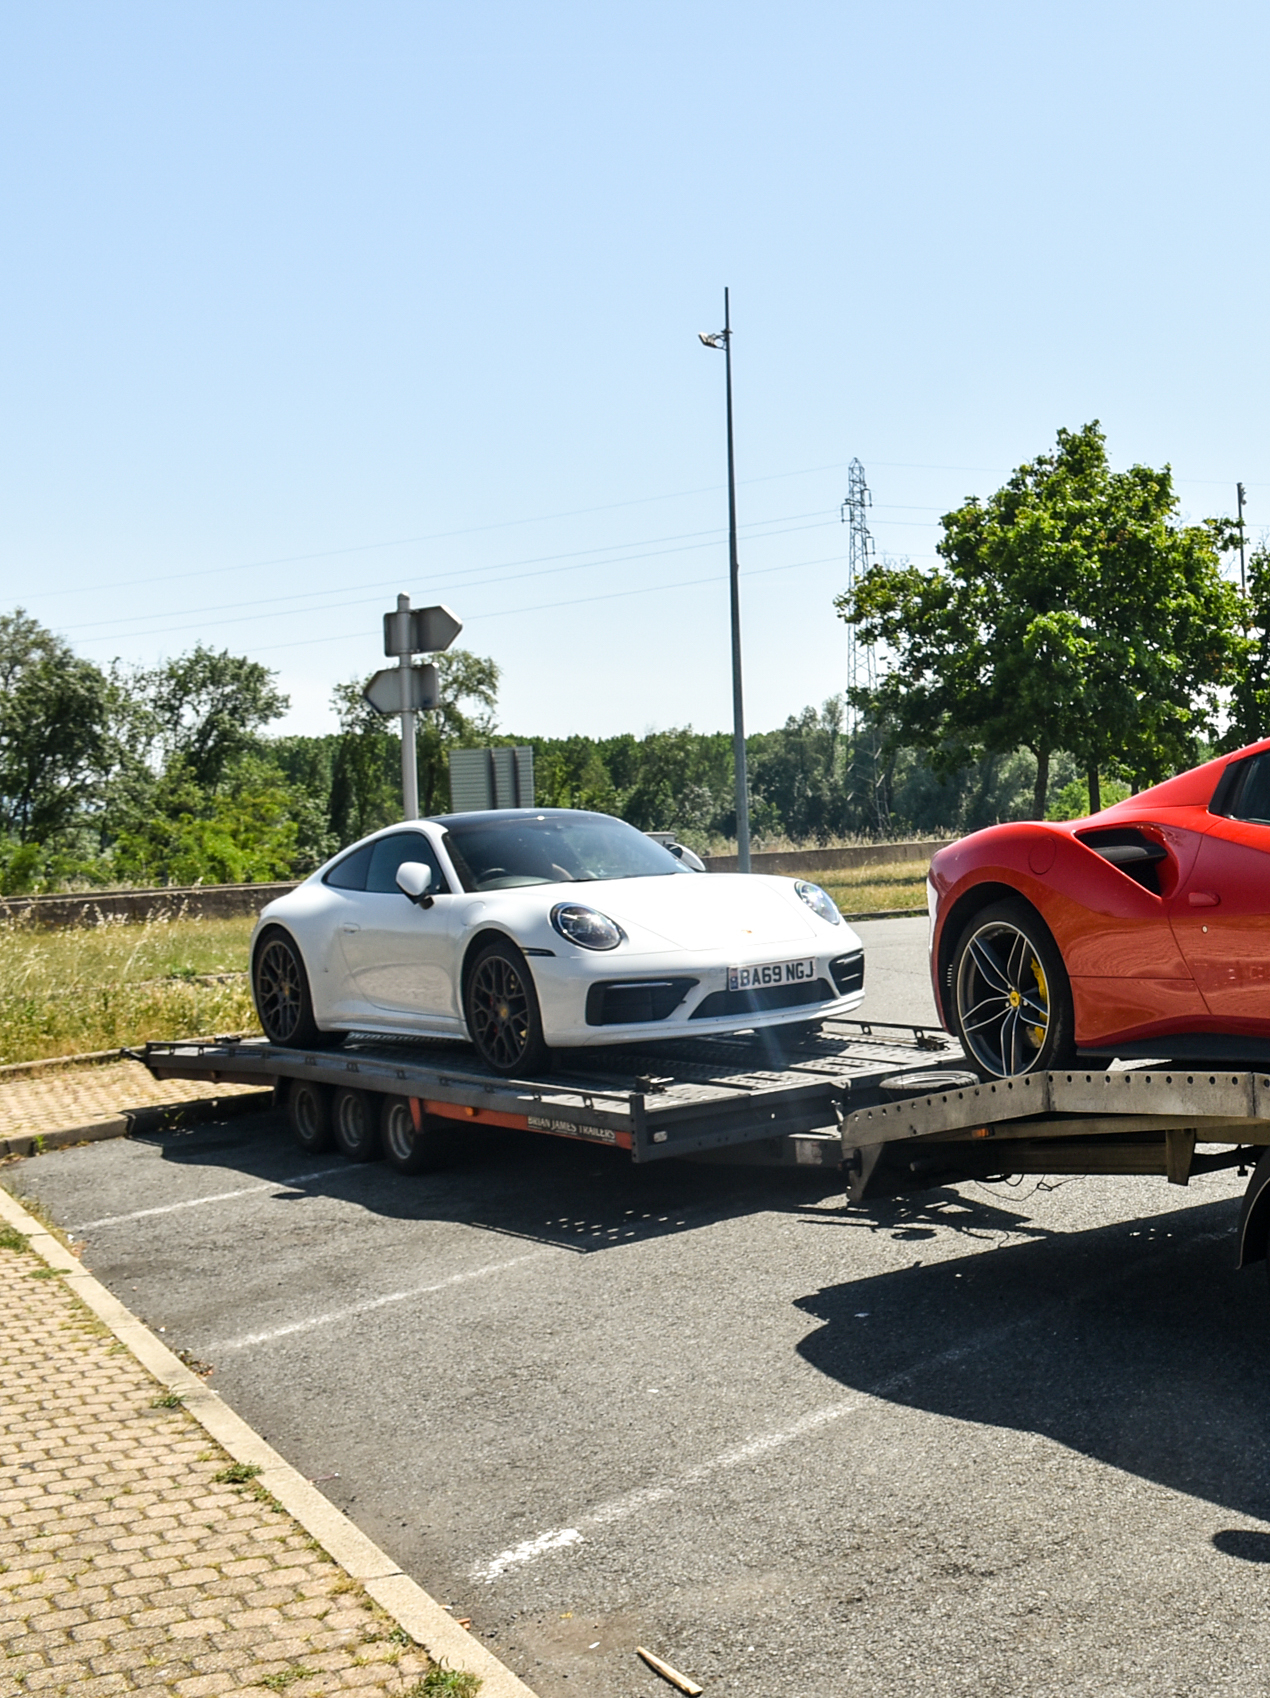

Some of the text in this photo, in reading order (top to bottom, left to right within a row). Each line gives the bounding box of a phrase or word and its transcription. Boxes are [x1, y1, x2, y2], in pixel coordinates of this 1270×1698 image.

[740, 961, 814, 987] BA69 NGJ
[528, 1115, 551, 1129] BRIAN
[551, 1119, 577, 1133] JAMES
[578, 1124, 616, 1139] TRAILERS
